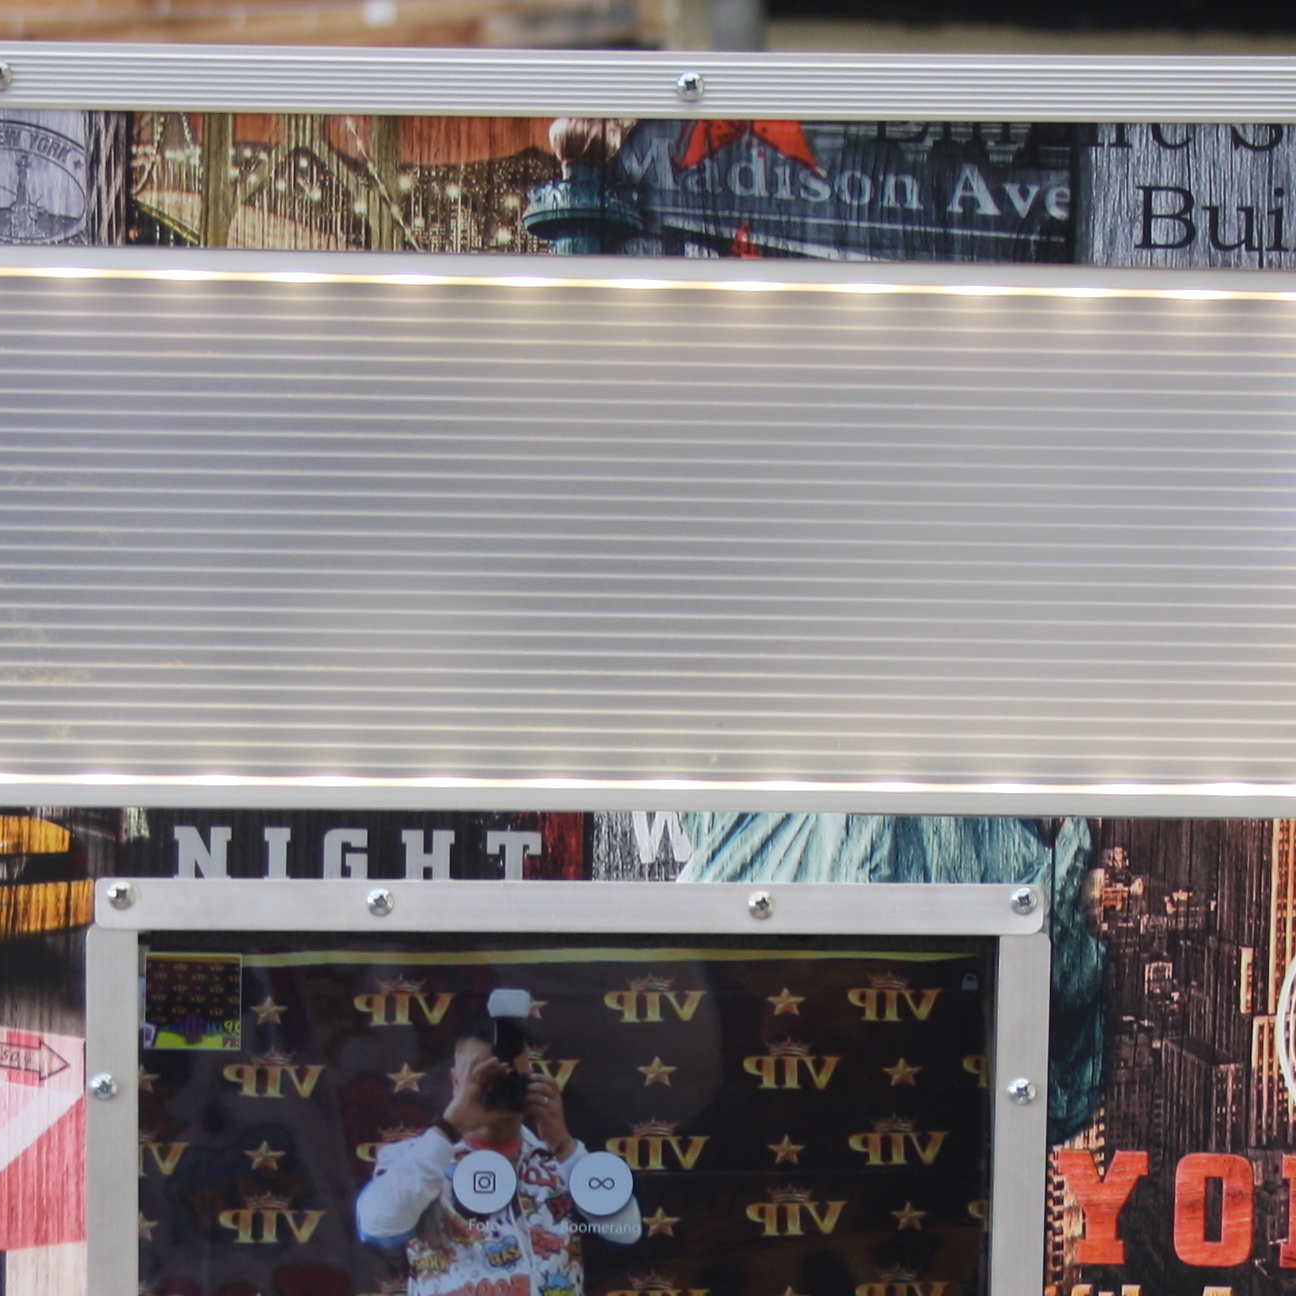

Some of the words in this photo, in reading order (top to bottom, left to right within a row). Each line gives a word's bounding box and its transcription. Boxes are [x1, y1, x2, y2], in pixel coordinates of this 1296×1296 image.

[29, 132, 74, 163] YORK
[620, 137, 924, 210] Madison
[947, 163, 1071, 220] Ave
[173, 826, 543, 880] NIGHT
[468, 1218, 500, 1233] Foto
[560, 1221, 642, 1237] Boomerang
